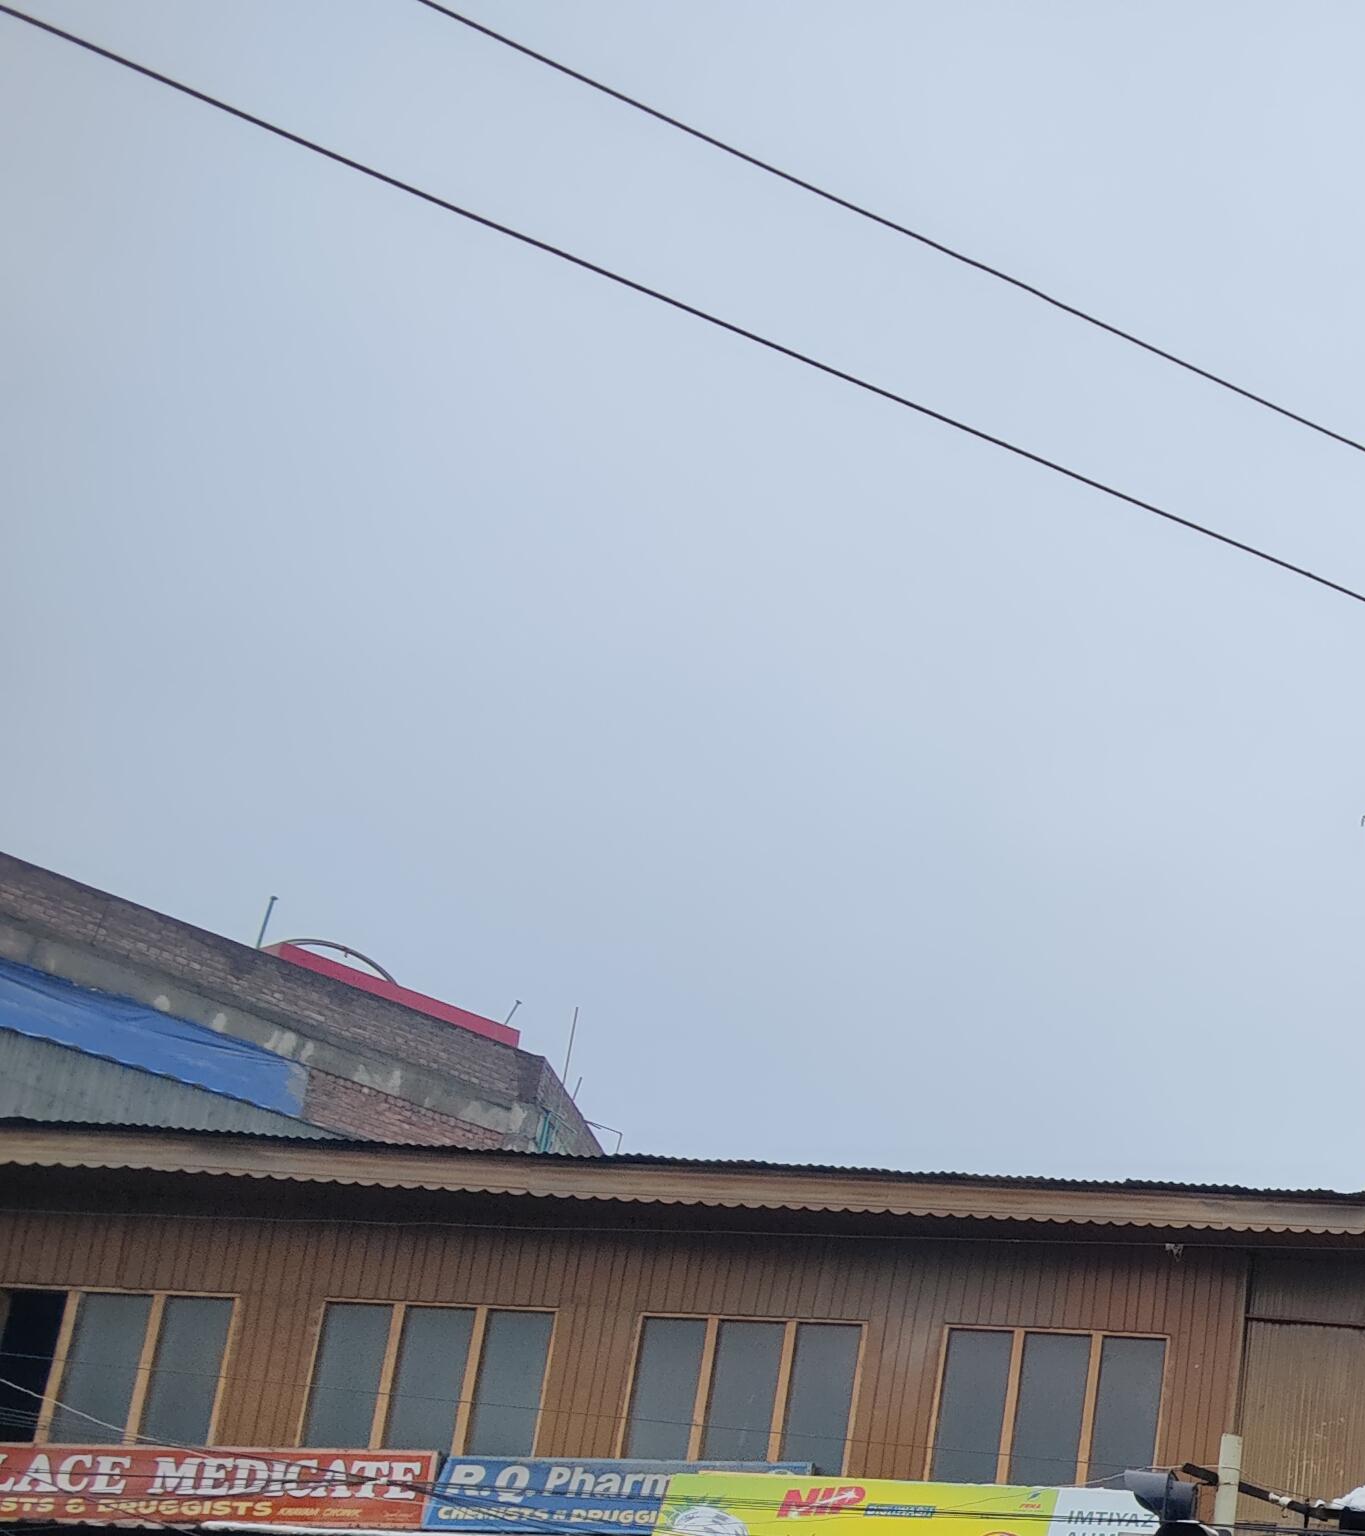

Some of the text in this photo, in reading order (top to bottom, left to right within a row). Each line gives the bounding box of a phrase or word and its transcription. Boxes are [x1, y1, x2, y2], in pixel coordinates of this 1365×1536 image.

[146, 1457, 422, 1500] MEDICATE
[97, 1499, 272, 1517] DRUGGISTS
[776, 1485, 866, 1519] NIP
[1066, 1509, 1154, 1529] IMTIYAZ
